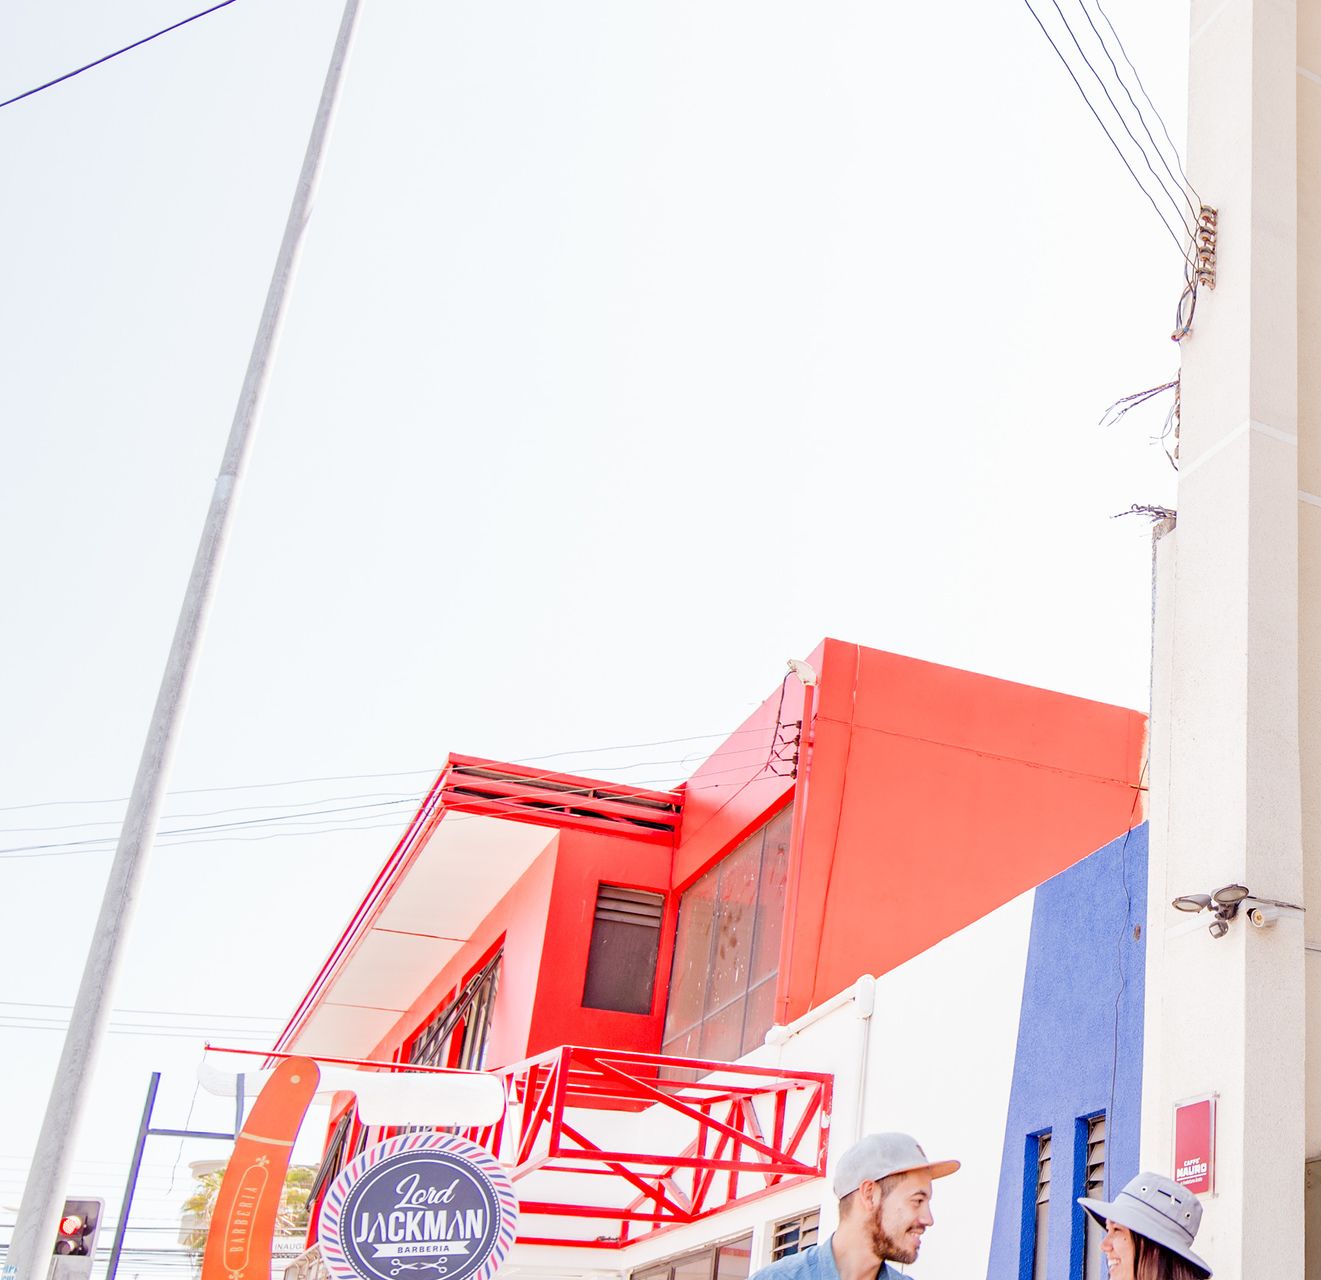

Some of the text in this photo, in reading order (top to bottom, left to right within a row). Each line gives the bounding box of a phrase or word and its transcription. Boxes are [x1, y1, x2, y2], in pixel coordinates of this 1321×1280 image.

[1176, 1163, 1207, 1178] MAURO
[394, 1173, 460, 1209] Lord
[229, 1187, 258, 1252] BARBERIA
[356, 1209, 483, 1243] JACKMAN
[397, 1245, 450, 1254] BARBERIA
